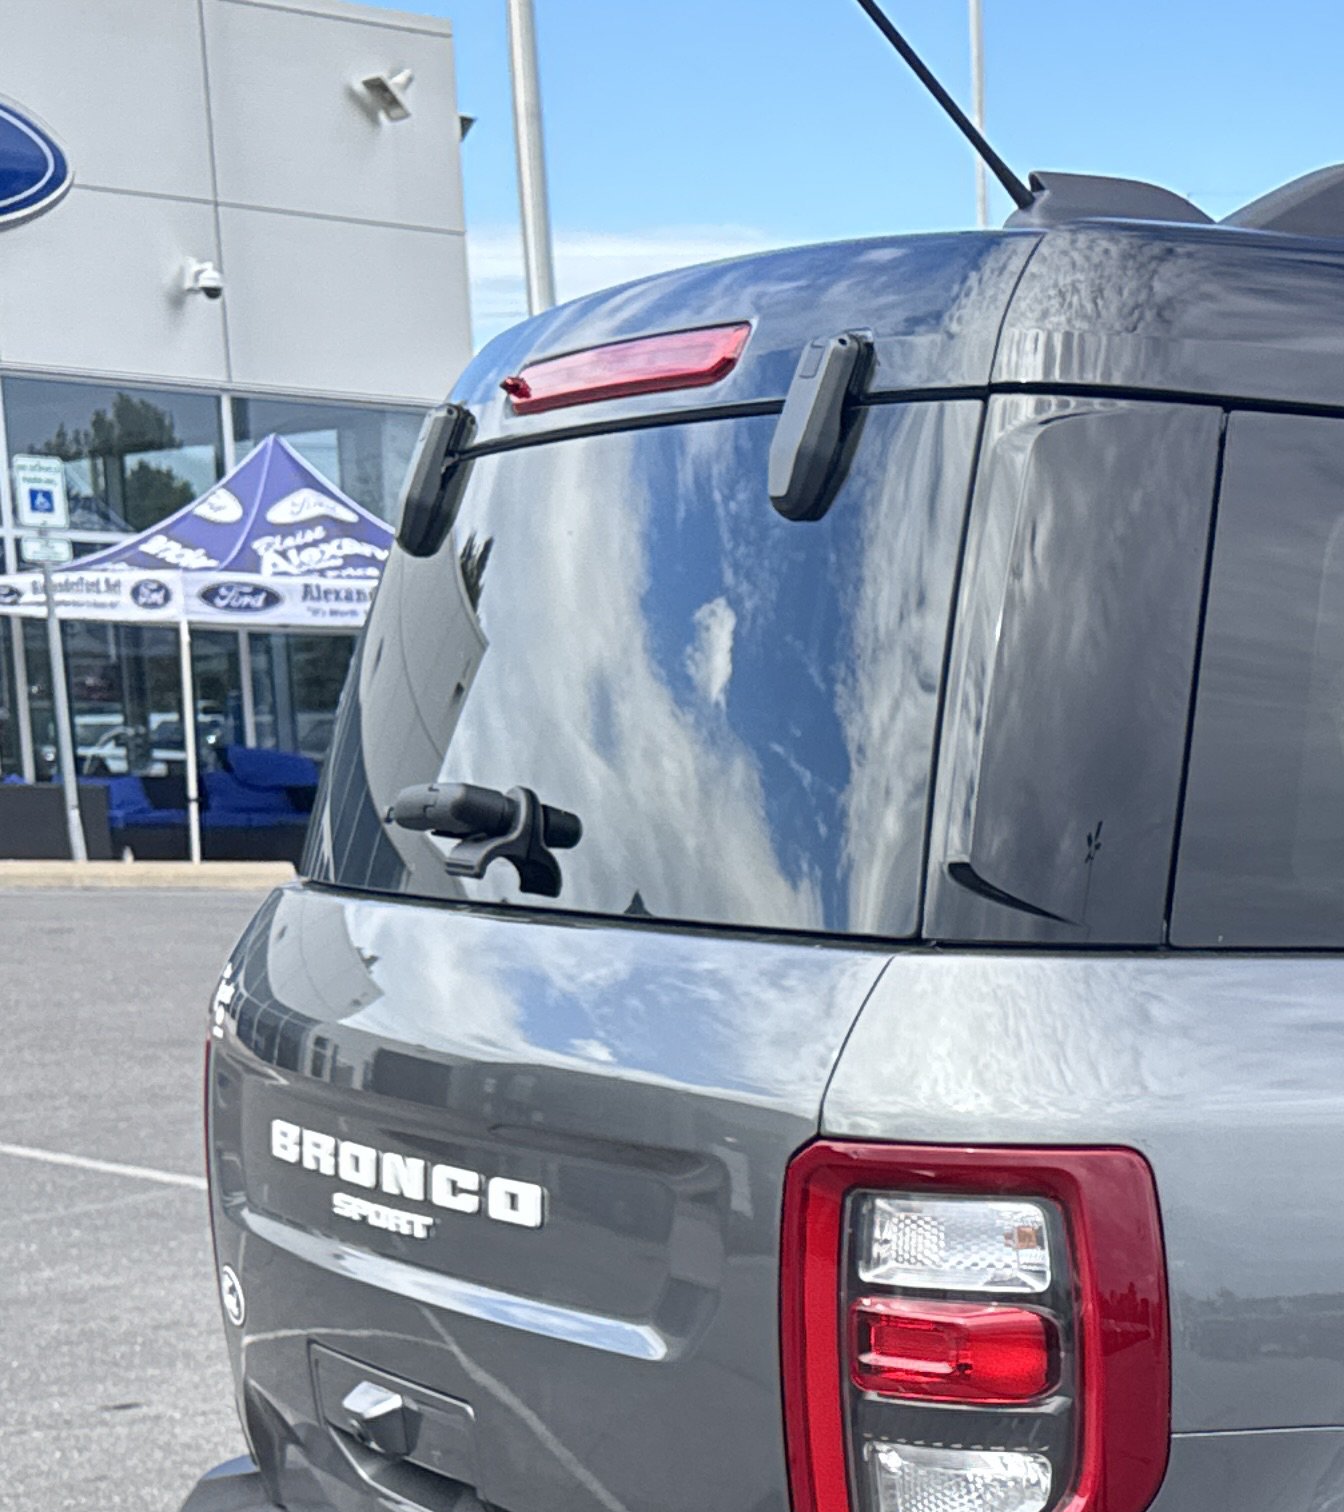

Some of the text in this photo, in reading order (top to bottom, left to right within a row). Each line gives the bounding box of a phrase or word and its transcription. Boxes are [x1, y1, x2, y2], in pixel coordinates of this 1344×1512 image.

[213, 583, 268, 608] Ford
[302, 583, 373, 602] Alexan
[271, 1118, 548, 1229] BRONCO
[332, 1191, 436, 1239] SPORT
